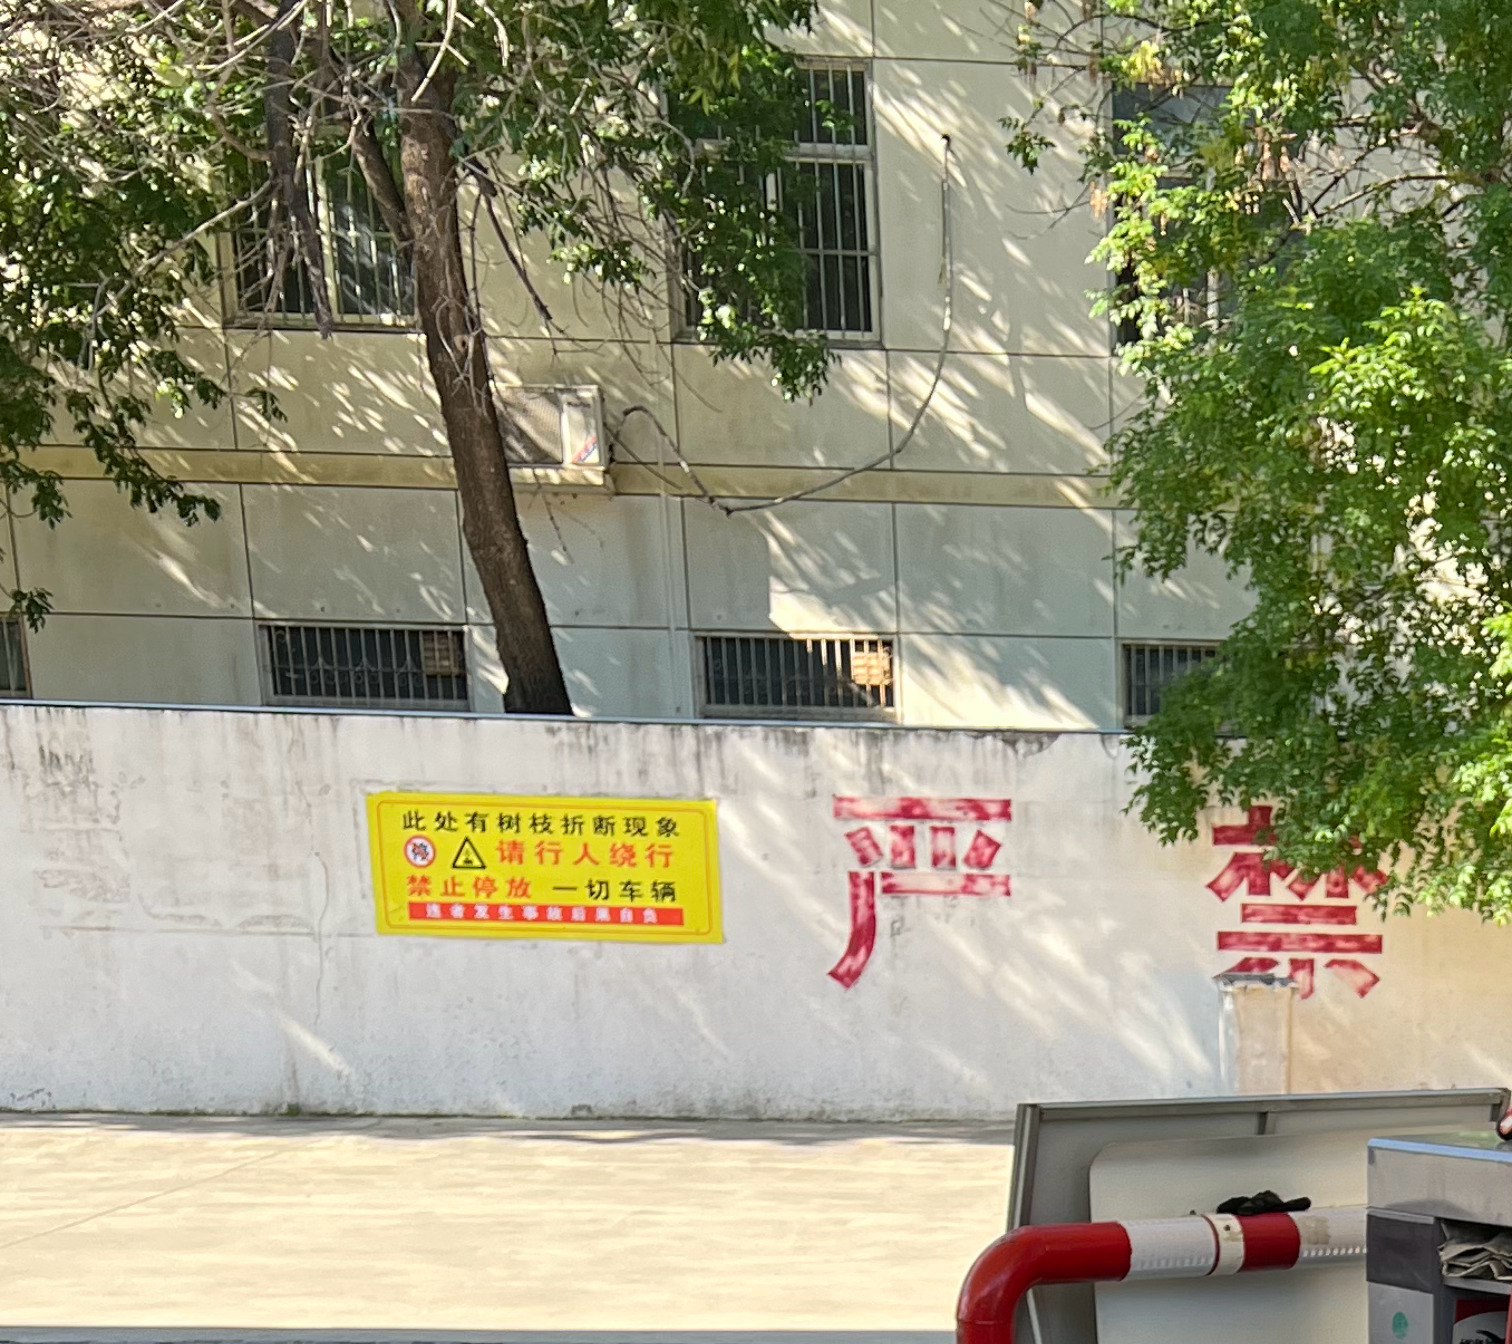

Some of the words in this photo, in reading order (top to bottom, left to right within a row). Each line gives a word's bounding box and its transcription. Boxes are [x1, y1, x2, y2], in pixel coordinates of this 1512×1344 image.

[402, 810, 680, 839] 此处有树枝折断现象
[497, 840, 675, 868] 请行人绕行
[407, 874, 533, 899] 禁止停放
[552, 879, 678, 902] 一切车辆
